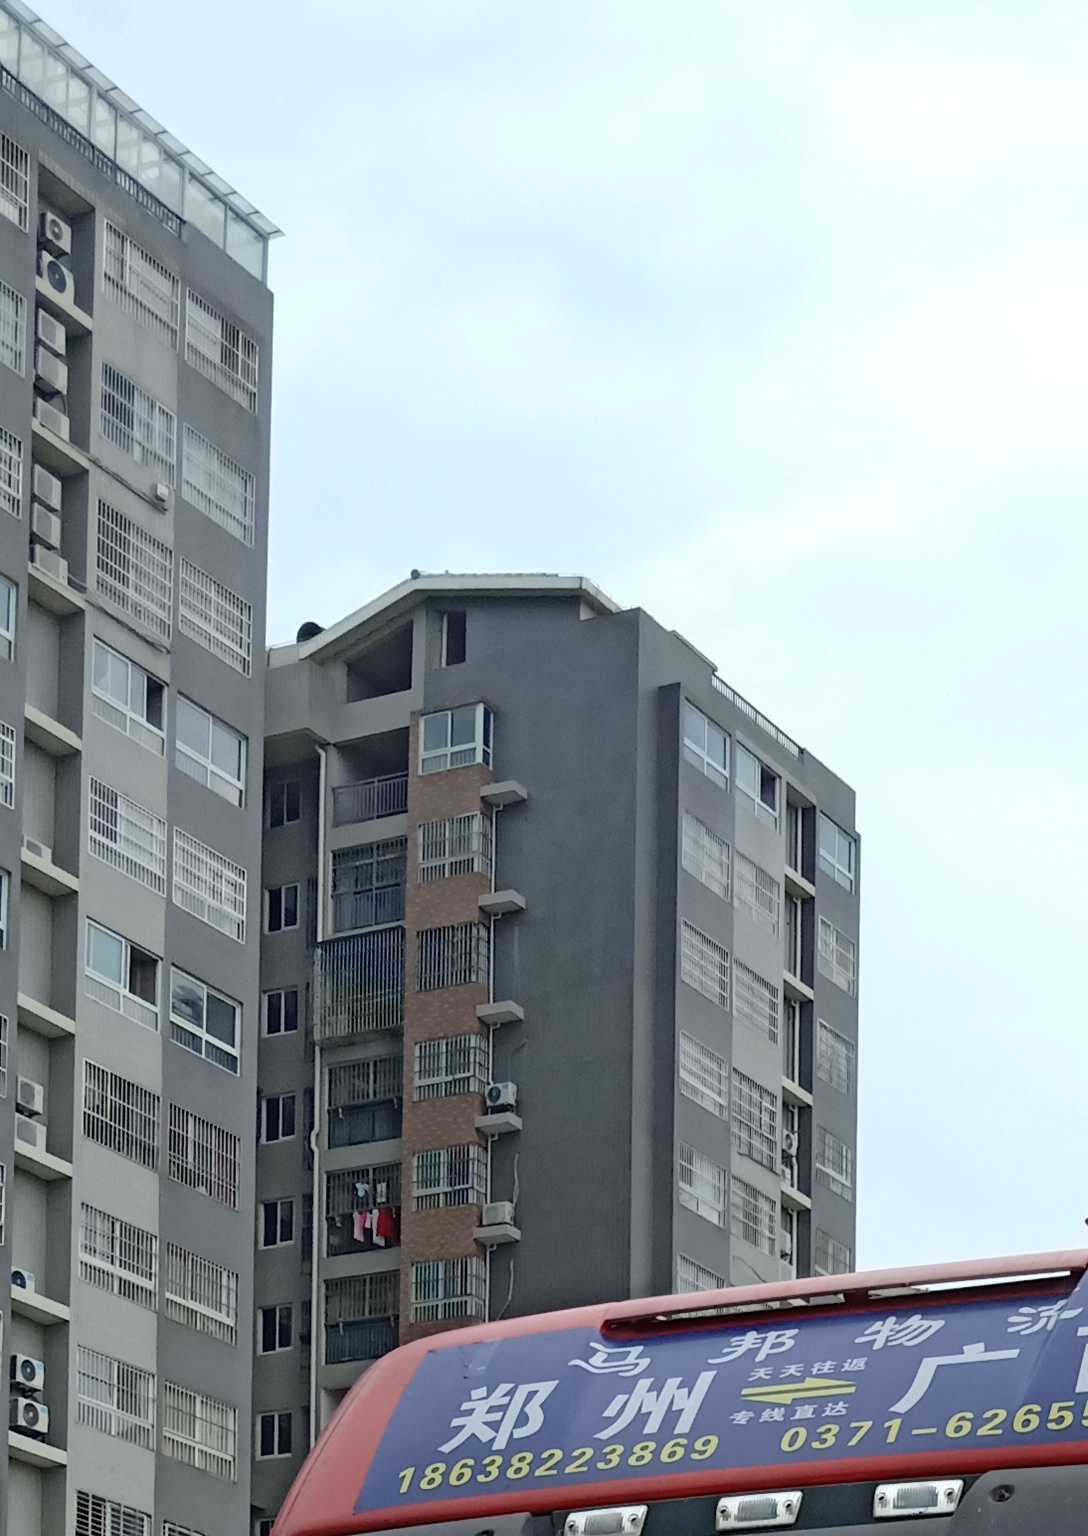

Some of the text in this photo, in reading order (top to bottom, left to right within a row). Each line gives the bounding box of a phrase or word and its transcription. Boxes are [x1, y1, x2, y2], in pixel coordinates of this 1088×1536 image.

[748, 1357, 868, 1381] 天天往返
[437, 1370, 720, 1454] 郑州
[729, 1401, 849, 1425] 专线直达
[398, 1434, 720, 1494] 18638223869
